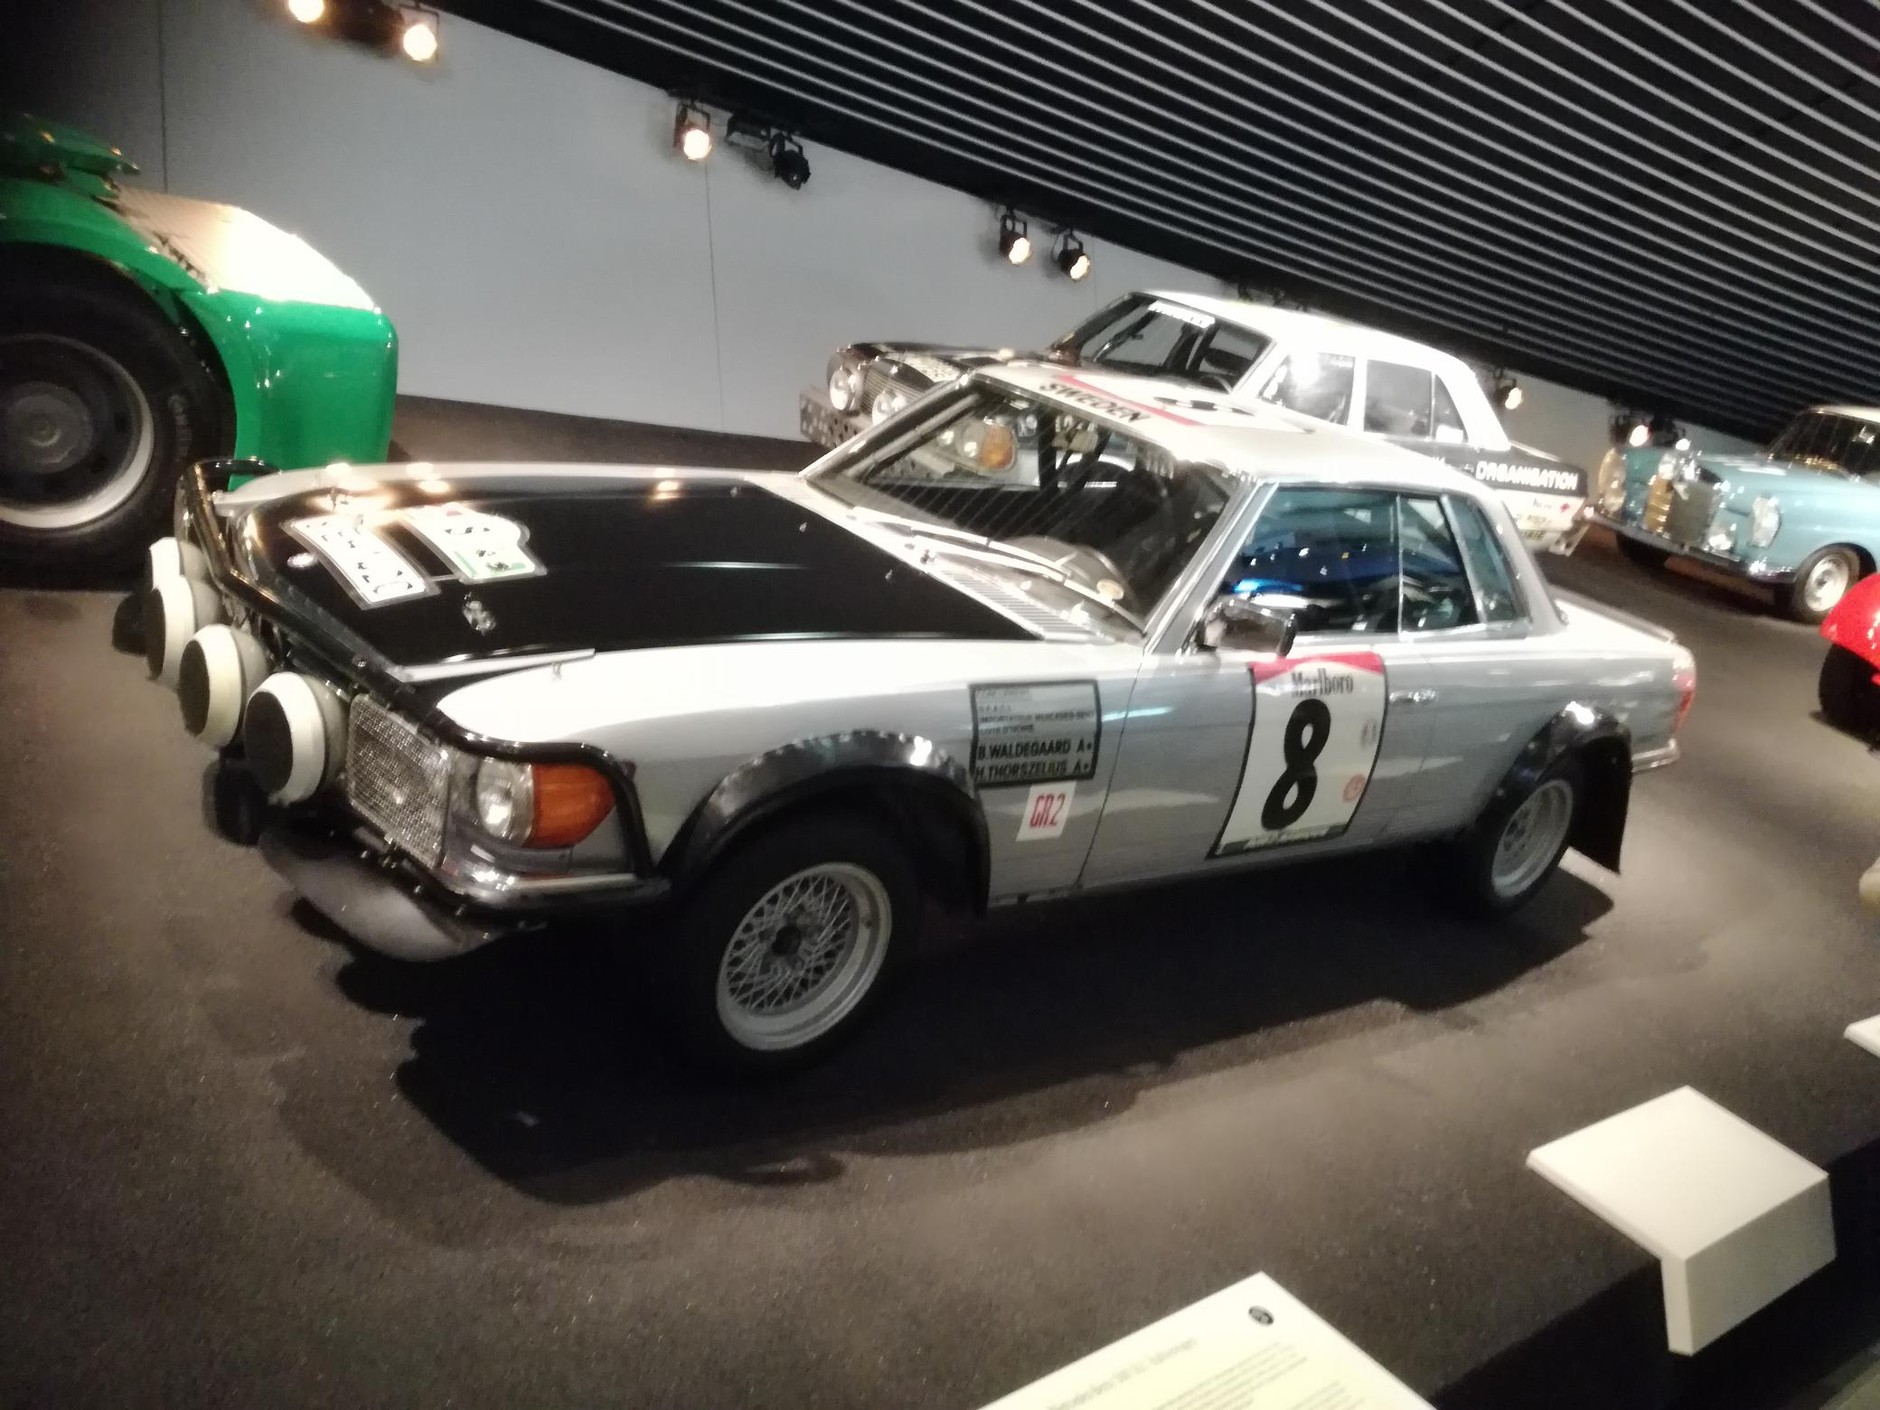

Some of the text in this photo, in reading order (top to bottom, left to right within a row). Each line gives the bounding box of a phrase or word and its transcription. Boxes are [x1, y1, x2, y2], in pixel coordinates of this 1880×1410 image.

[1040, 381, 1152, 424] SWEDEN
[1475, 461, 1579, 491] ORGANISATION
[1290, 667, 1355, 698] Marlboro
[1261, 698, 1332, 831] 8
